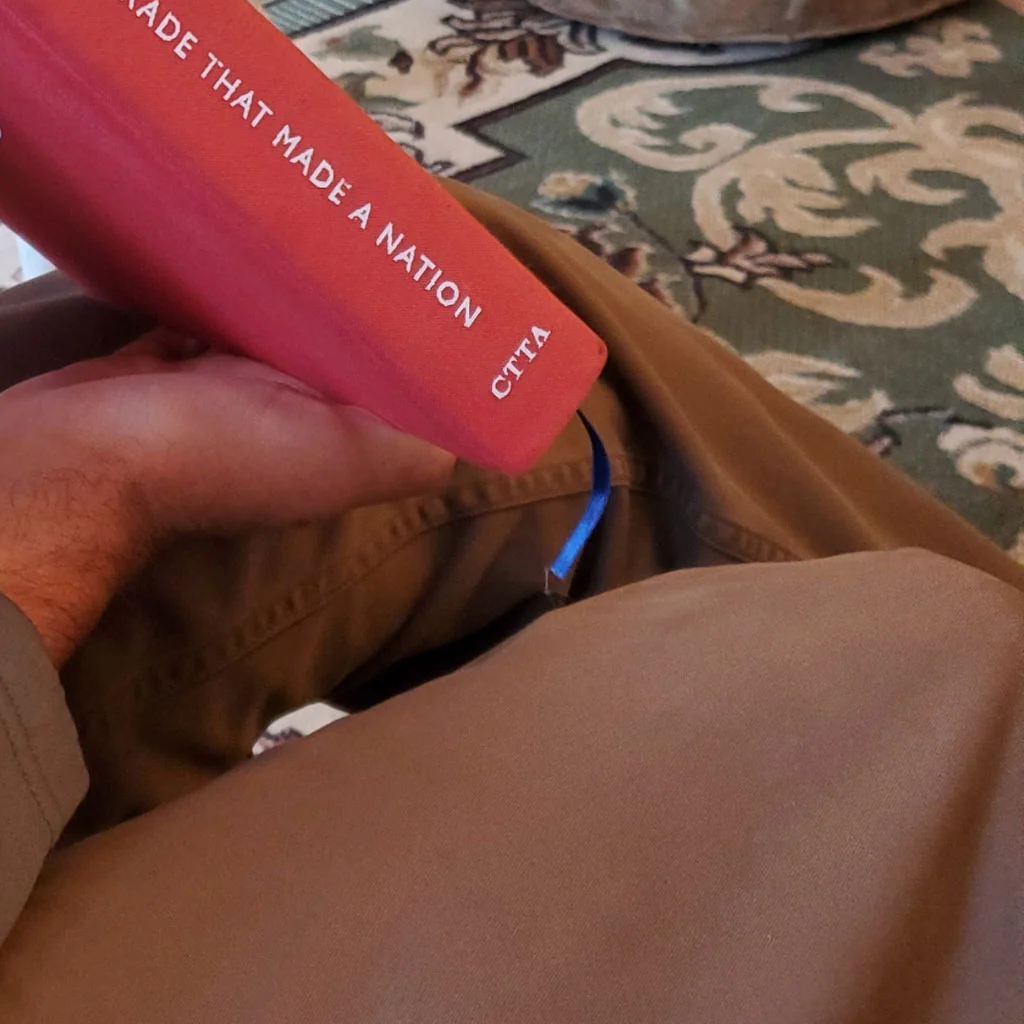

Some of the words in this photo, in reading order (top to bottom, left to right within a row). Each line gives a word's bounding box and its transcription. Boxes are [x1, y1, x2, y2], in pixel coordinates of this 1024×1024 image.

[199, 51, 274, 129] THAT
[271, 124, 353, 206] MADE
[347, 202, 373, 230] A
[375, 222, 483, 328] NATION
[490, 324, 551, 400] CTTA
